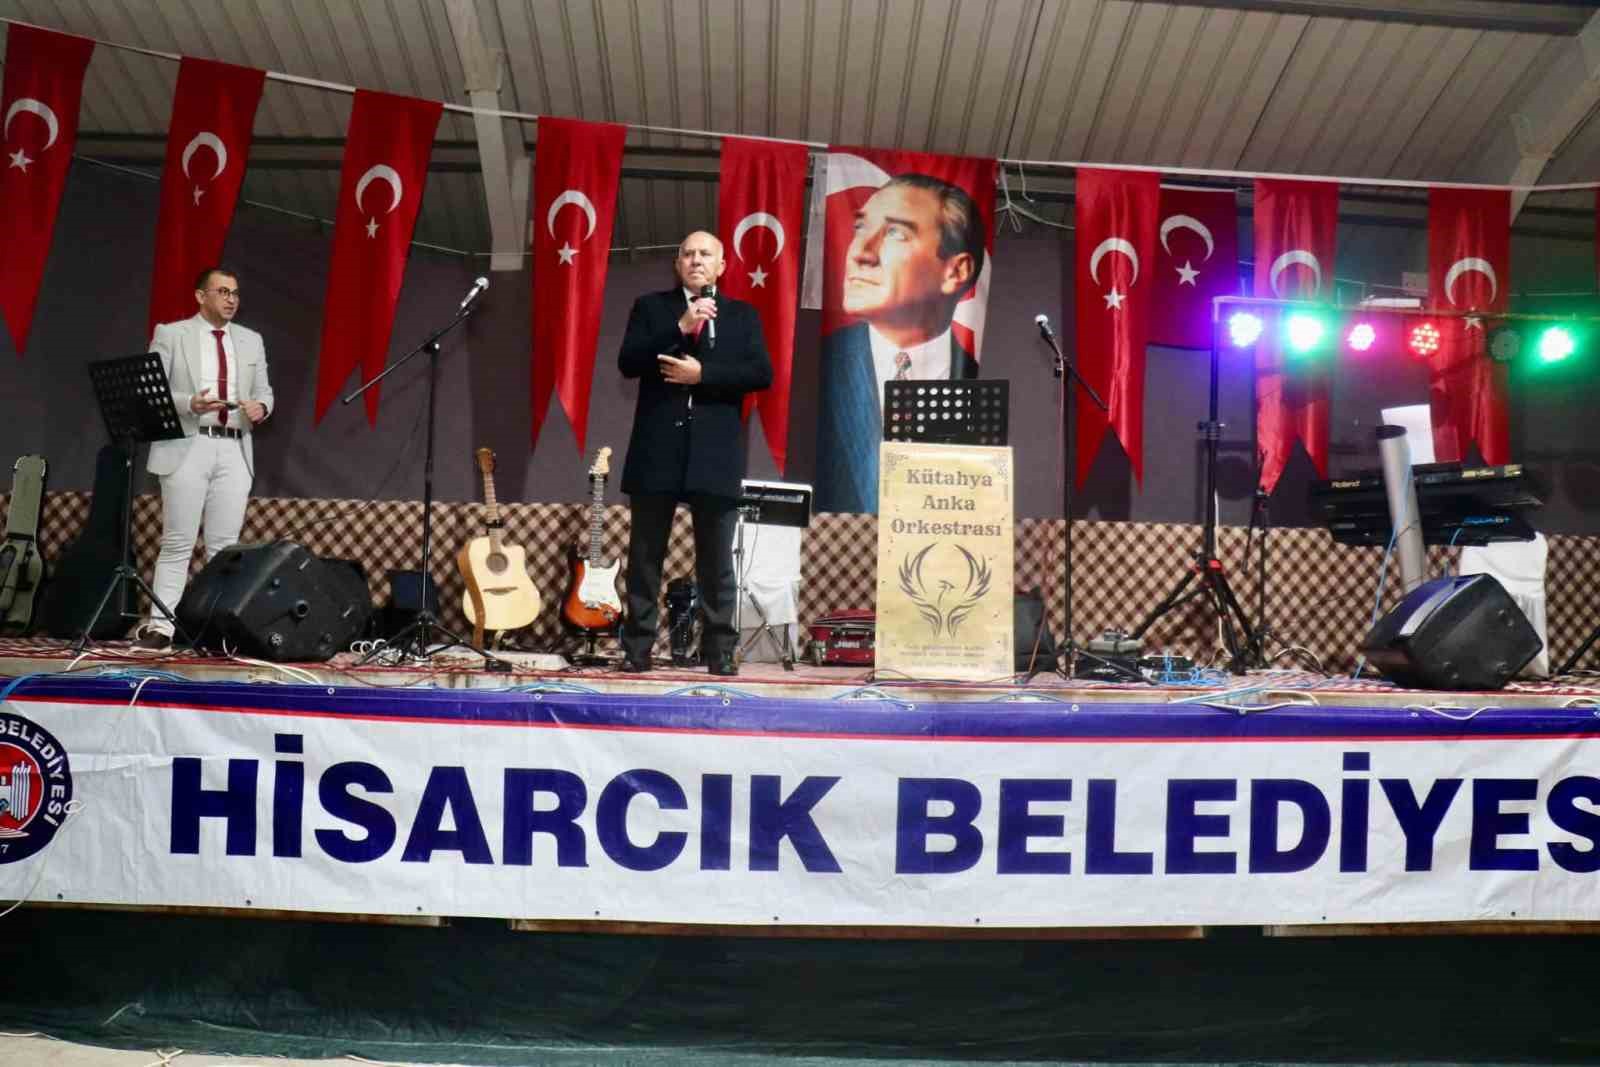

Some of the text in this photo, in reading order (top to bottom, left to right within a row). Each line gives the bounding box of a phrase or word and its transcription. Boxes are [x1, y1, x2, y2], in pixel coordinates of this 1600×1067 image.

[906, 468, 993, 490] Kütahya
[921, 494, 976, 512] Anka
[890, 518, 1002, 537] Orkestrası
[170, 733, 843, 873] HİSARCIK
